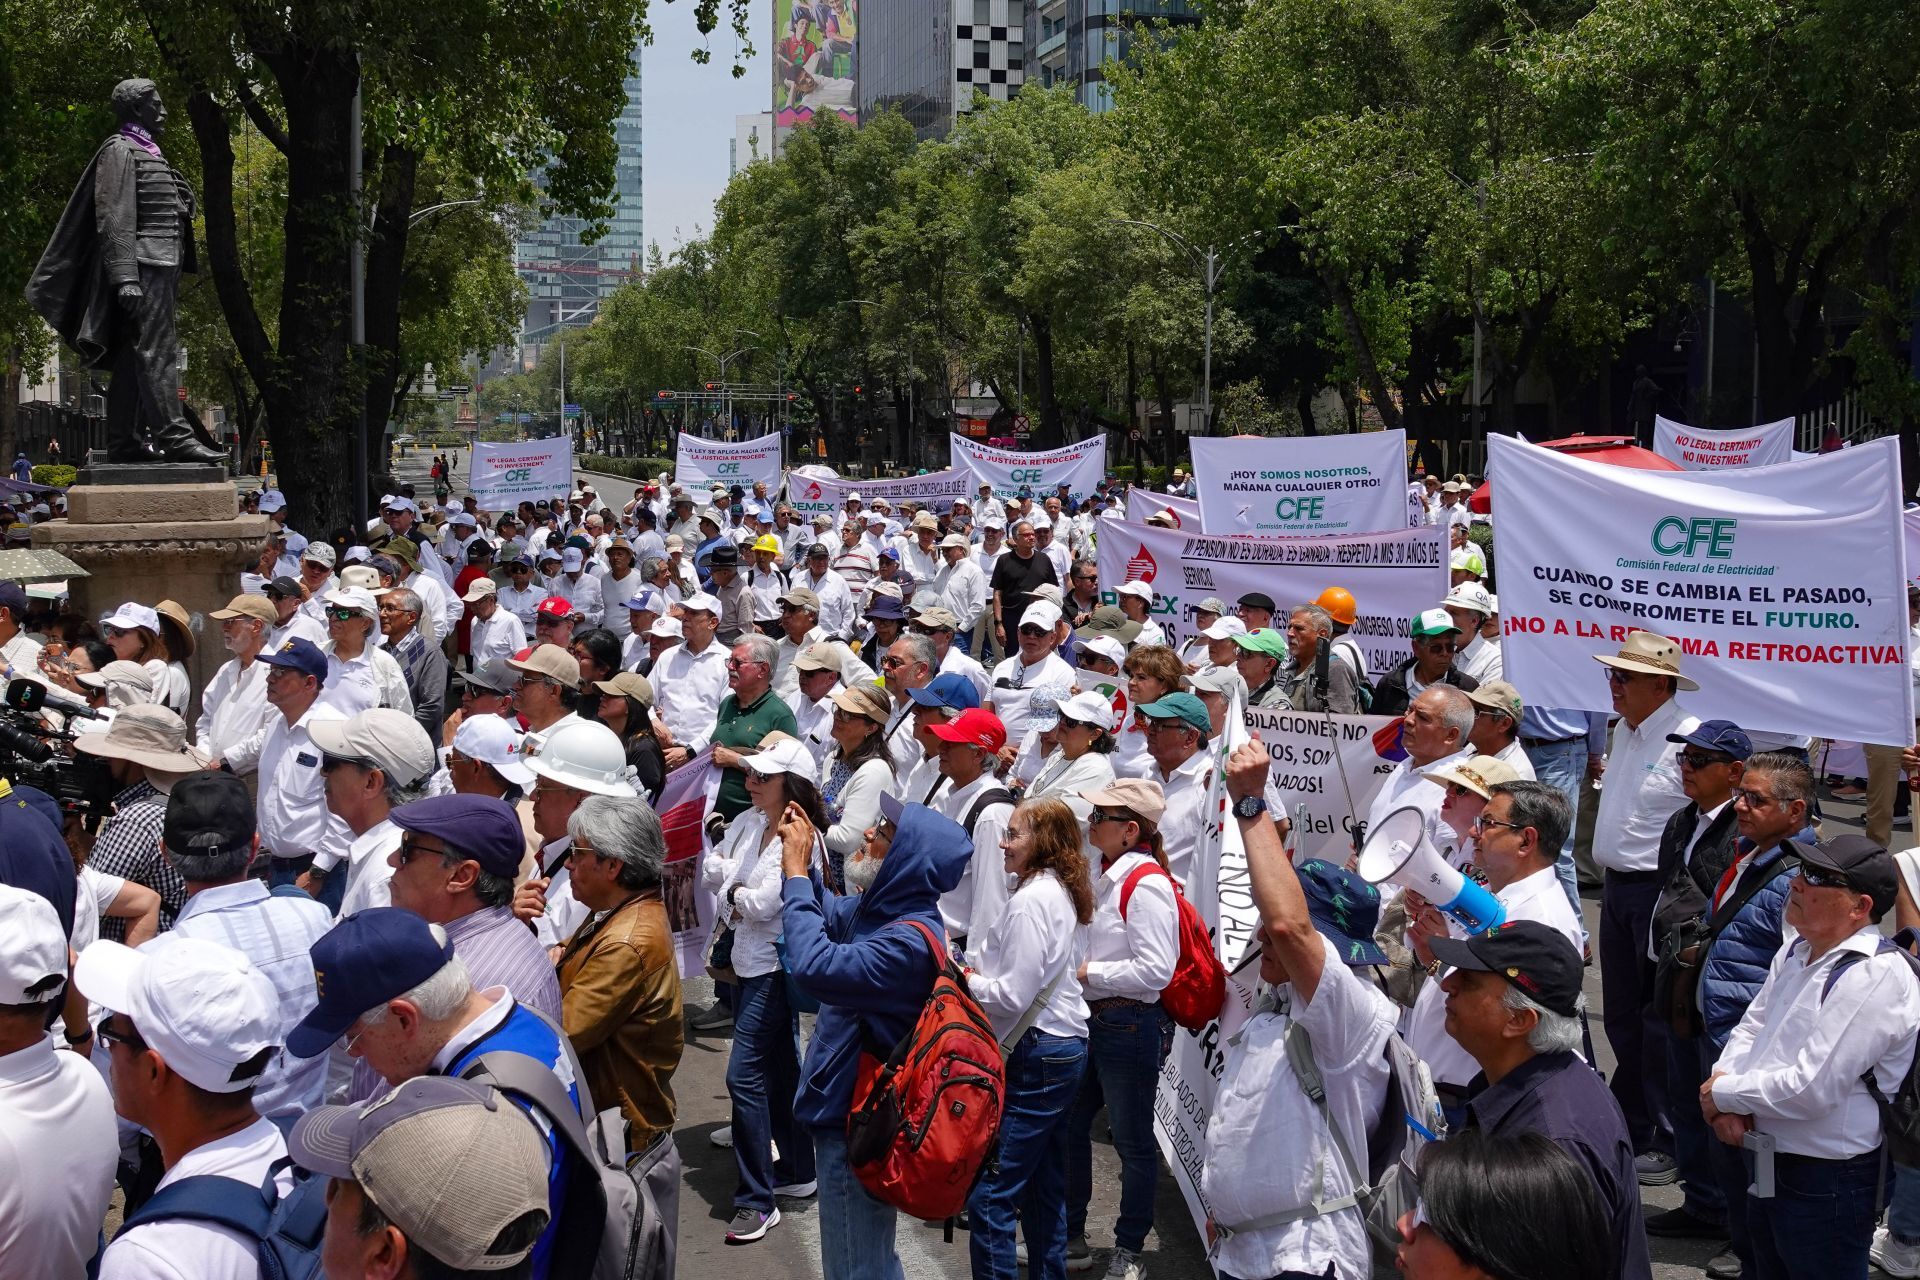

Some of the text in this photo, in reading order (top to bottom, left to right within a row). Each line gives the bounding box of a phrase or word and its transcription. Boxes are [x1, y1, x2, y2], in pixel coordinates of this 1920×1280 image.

[954, 438, 962, 446] SI
[964, 440, 976, 450] LA
[1675, 435, 1764, 452] NO LEGAL CERTAINTY
[518, 454, 553, 462] CERTAINTY
[972, 452, 984, 460] LA
[986, 457, 1028, 466] JUSTICIA
[1029, 453, 1084, 466] RETROCEDE.
[1682, 450, 1749, 465] NO INVESTMENT.
[505, 468, 532, 482] CFE
[717, 462, 741, 475] CFE
[1011, 469, 1043, 484] CFE
[1230, 466, 1372, 481] ¡HOY SOMOS NOSOTROS,
[497, 486, 520, 494] retired
[903, 484, 918, 495] HACER
[951, 480, 961, 493] QUE
[1223, 478, 1381, 492] MAÑANA CUALQUIER OTRO!
[1276, 496, 1325, 521] CFE
[1256, 520, 1348, 530] Comisión Federal de Electricidad
[1651, 515, 1738, 559] CFE
[1182, 538, 1195, 556] MI
[1227, 541, 1239, 560] NO
[1240, 542, 1252, 560] ES
[1251, 543, 1283, 564] DORADA,
[1286, 545, 1298, 562] ES
[1299, 544, 1330, 563] GANADA
[1336, 543, 1371, 564] RESPETO
[1372, 543, 1379, 564] A
[1379, 543, 1394, 564] MIS
[1395, 543, 1404, 564] 30
[1405, 538, 1429, 564] AÑOS
[1429, 542, 1440, 564] DE
[1616, 557, 1775, 576] Comisión Federal de Electricidad
[1183, 566, 1217, 590] SERVICIO.
[1533, 566, 1872, 607] CUANDO SE CAMBIA EL PASADO,
[1549, 589, 1860, 629] SE COMPROMETE EL FUTURO.
[1504, 616, 1545, 636] ¡NO
[1553, 619, 1569, 636] A
[1576, 620, 1605, 639] LA
[1728, 641, 1904, 665] RETROACTIVA!
[1343, 723, 1368, 741] NO
[1303, 747, 1335, 766] SON
[1193, 1106, 1207, 1132] DE
[1161, 1101, 1197, 1163] NUESTROS
